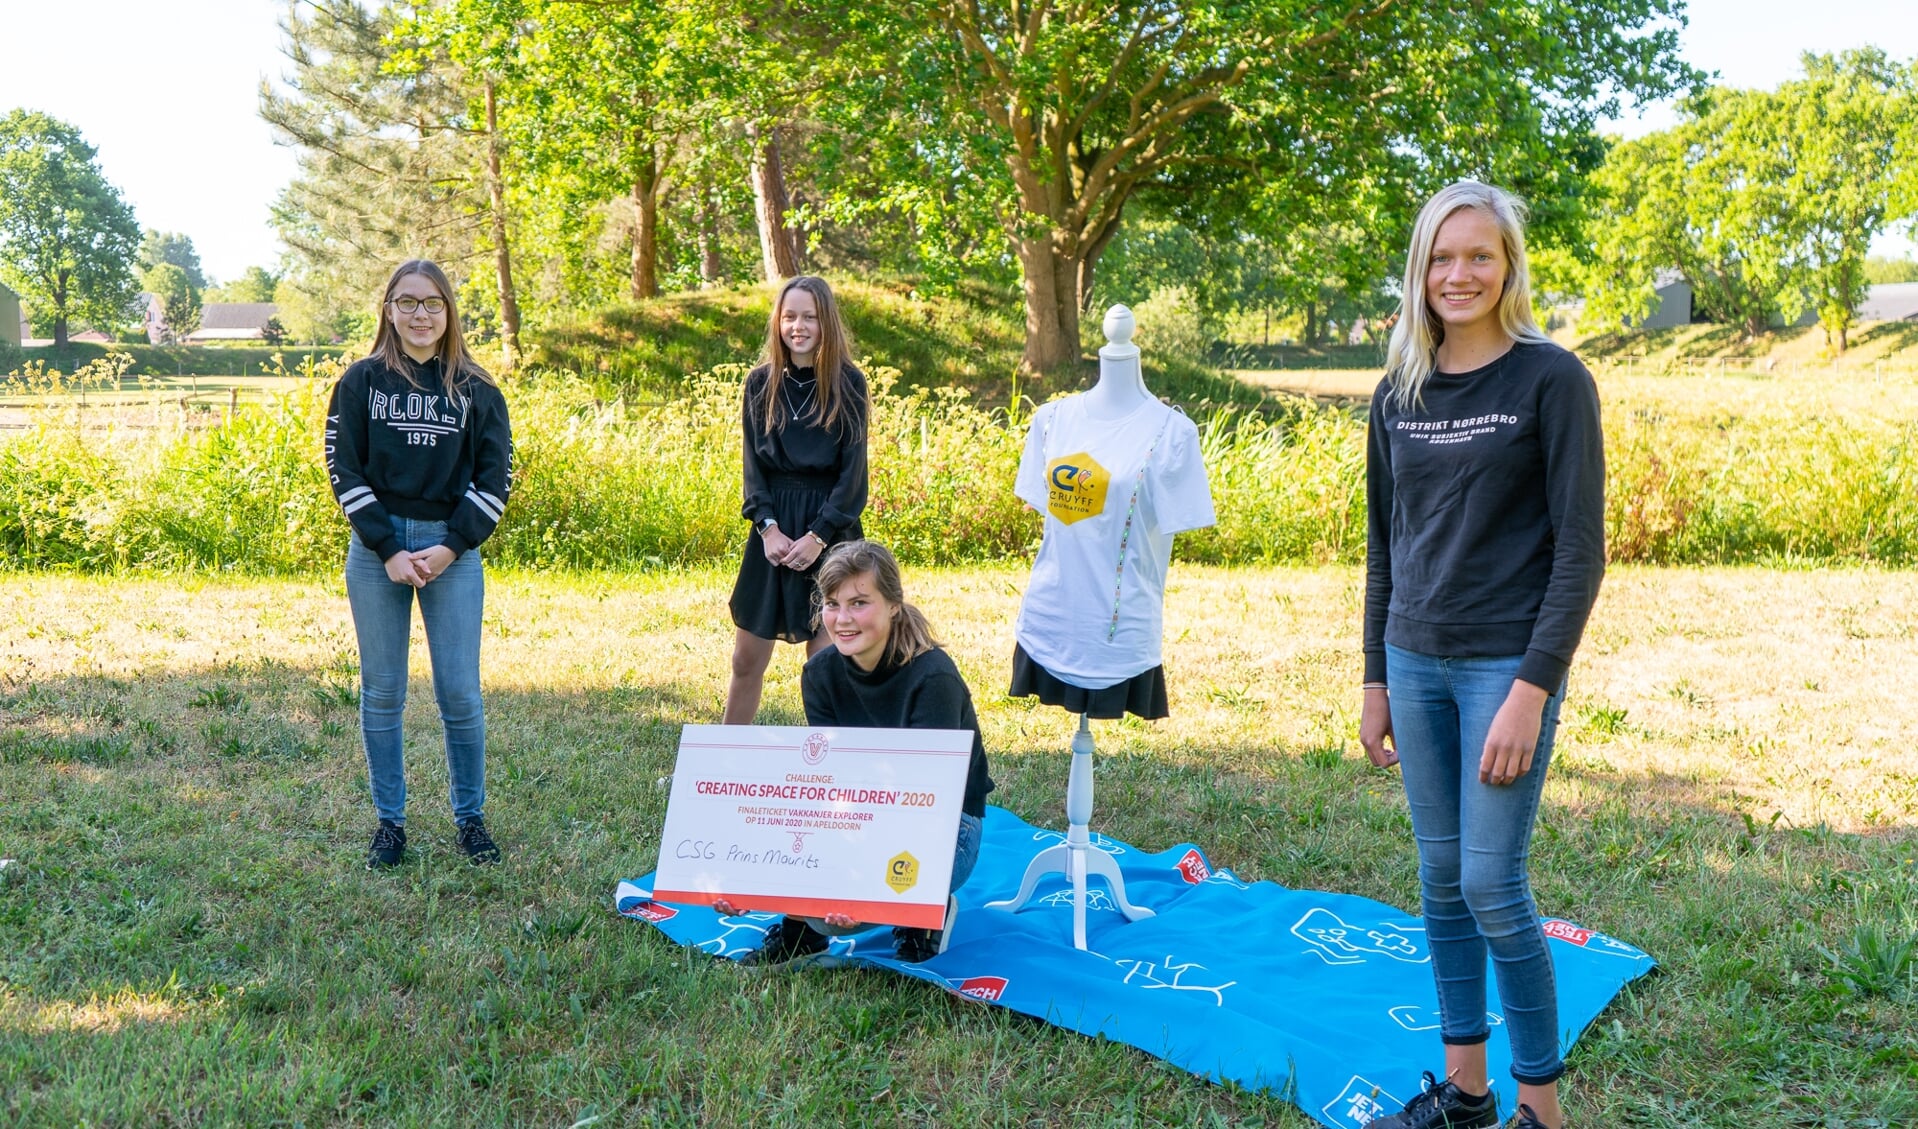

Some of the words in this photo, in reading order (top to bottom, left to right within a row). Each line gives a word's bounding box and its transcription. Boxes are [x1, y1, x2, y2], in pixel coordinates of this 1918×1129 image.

[1397, 421, 1449, 430] DISTRIKT
[1453, 414, 1517, 428] NØRREBRO
[1470, 426, 1497, 435] BRAND
[407, 431, 438, 447] 1975
[1049, 490, 1094, 506] CRUYFF
[785, 773, 834, 784] CHALLENGE:
[759, 784, 798, 799] SPACE
[799, 786, 826, 801] FOR
[901, 791, 935, 807] 2020
[737, 806, 787, 816] FINALETICKET
[788, 808, 832, 819] VAKKANJER
[833, 811, 874, 821] EXPLORER
[745, 816, 756, 824] OP
[757, 817, 766, 825] 11
[766, 818, 784, 826] JUNI
[784, 819, 803, 827] 2020
[803, 820, 813, 828] IN
[813, 821, 861, 831] APELDOORN
[676, 839, 716, 860] CSG
[726, 844, 759, 864] Prins
[762, 849, 820, 869] Maurits
[1346, 1105, 1374, 1126] NE
